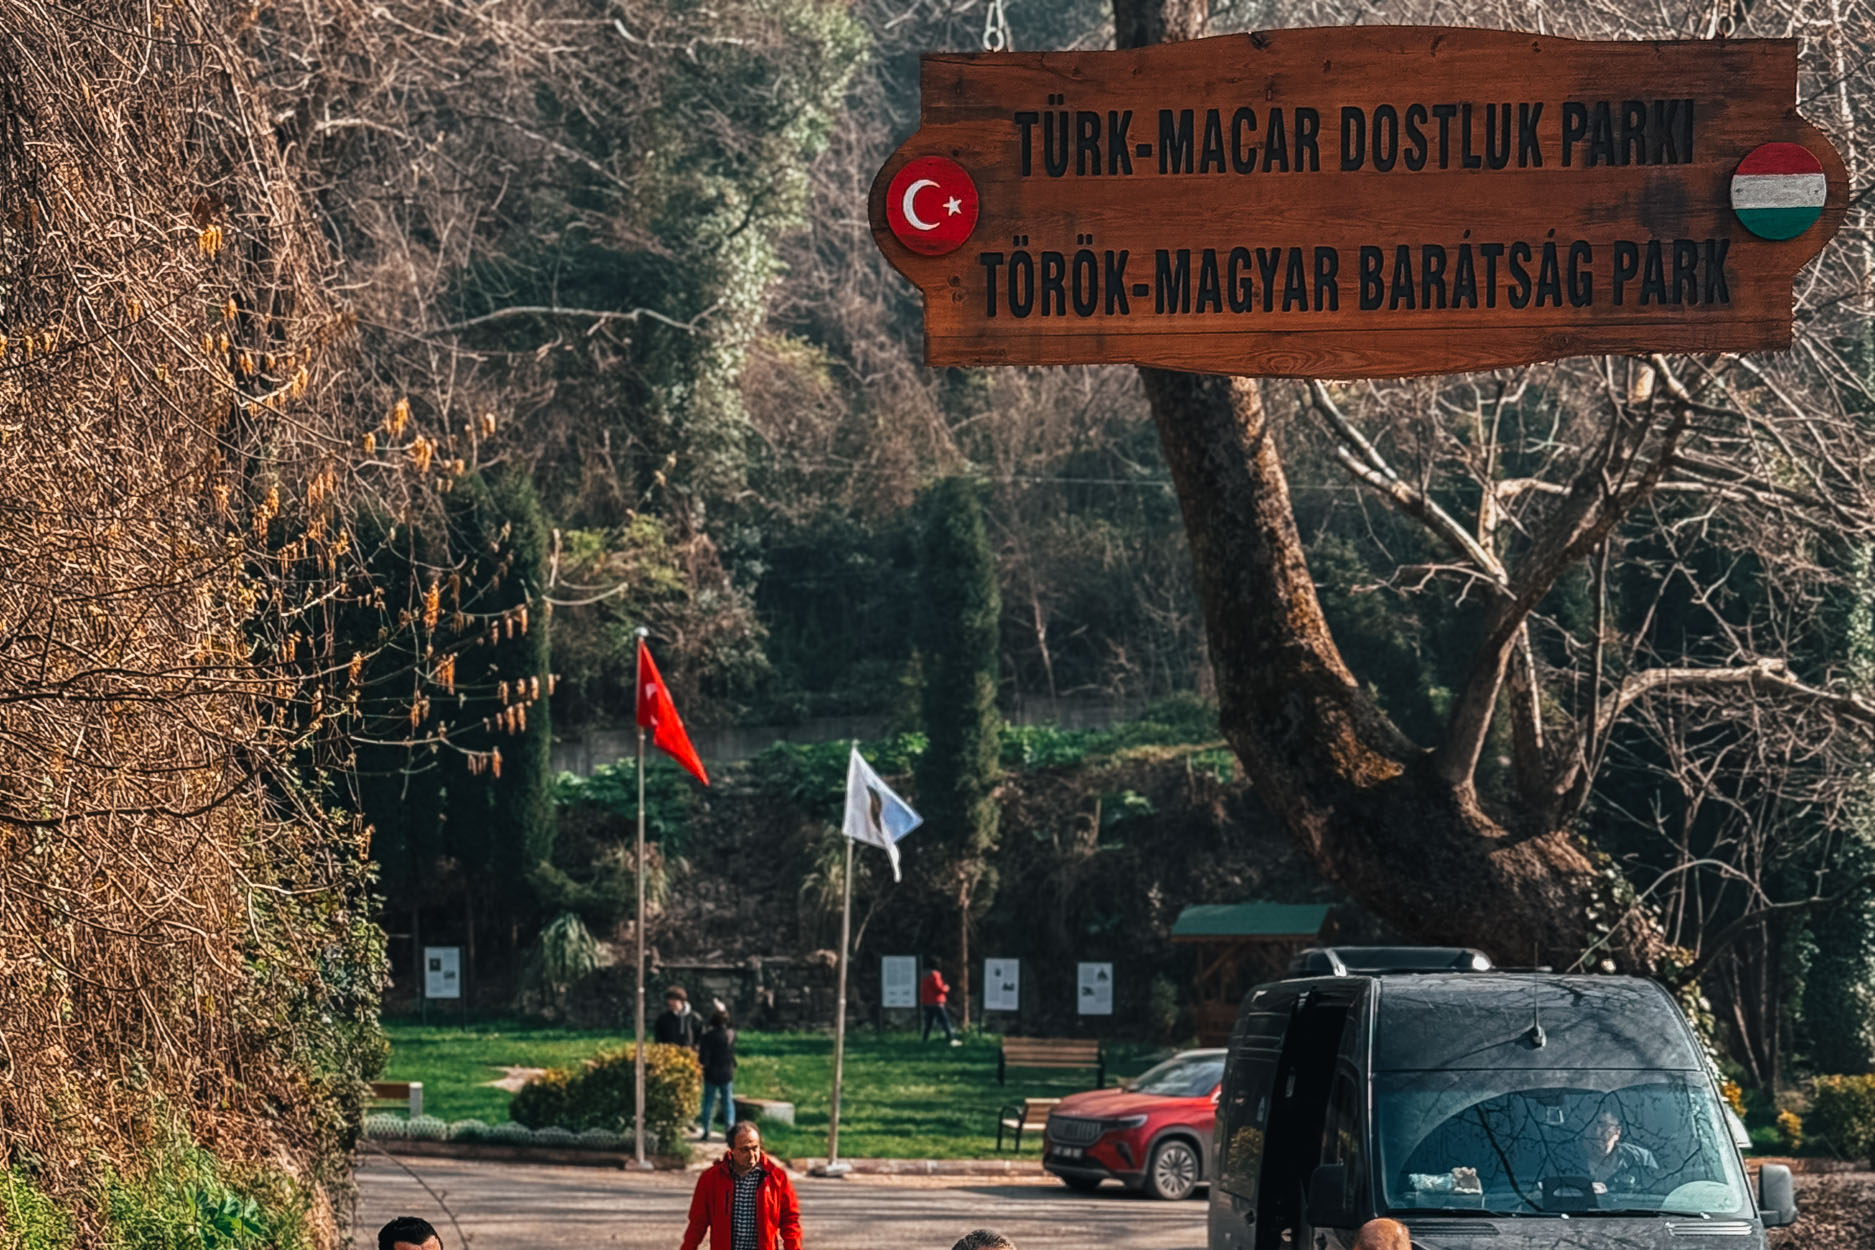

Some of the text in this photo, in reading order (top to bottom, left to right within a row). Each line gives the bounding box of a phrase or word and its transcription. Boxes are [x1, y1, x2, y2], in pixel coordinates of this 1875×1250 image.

[1013, 94, 1321, 178] TÜRK-MACAR
[1340, 102, 1544, 172] DOSTLUK
[979, 228, 1731, 318] TÖRÖK-MAGYAR BARÁTSÁG PARK
